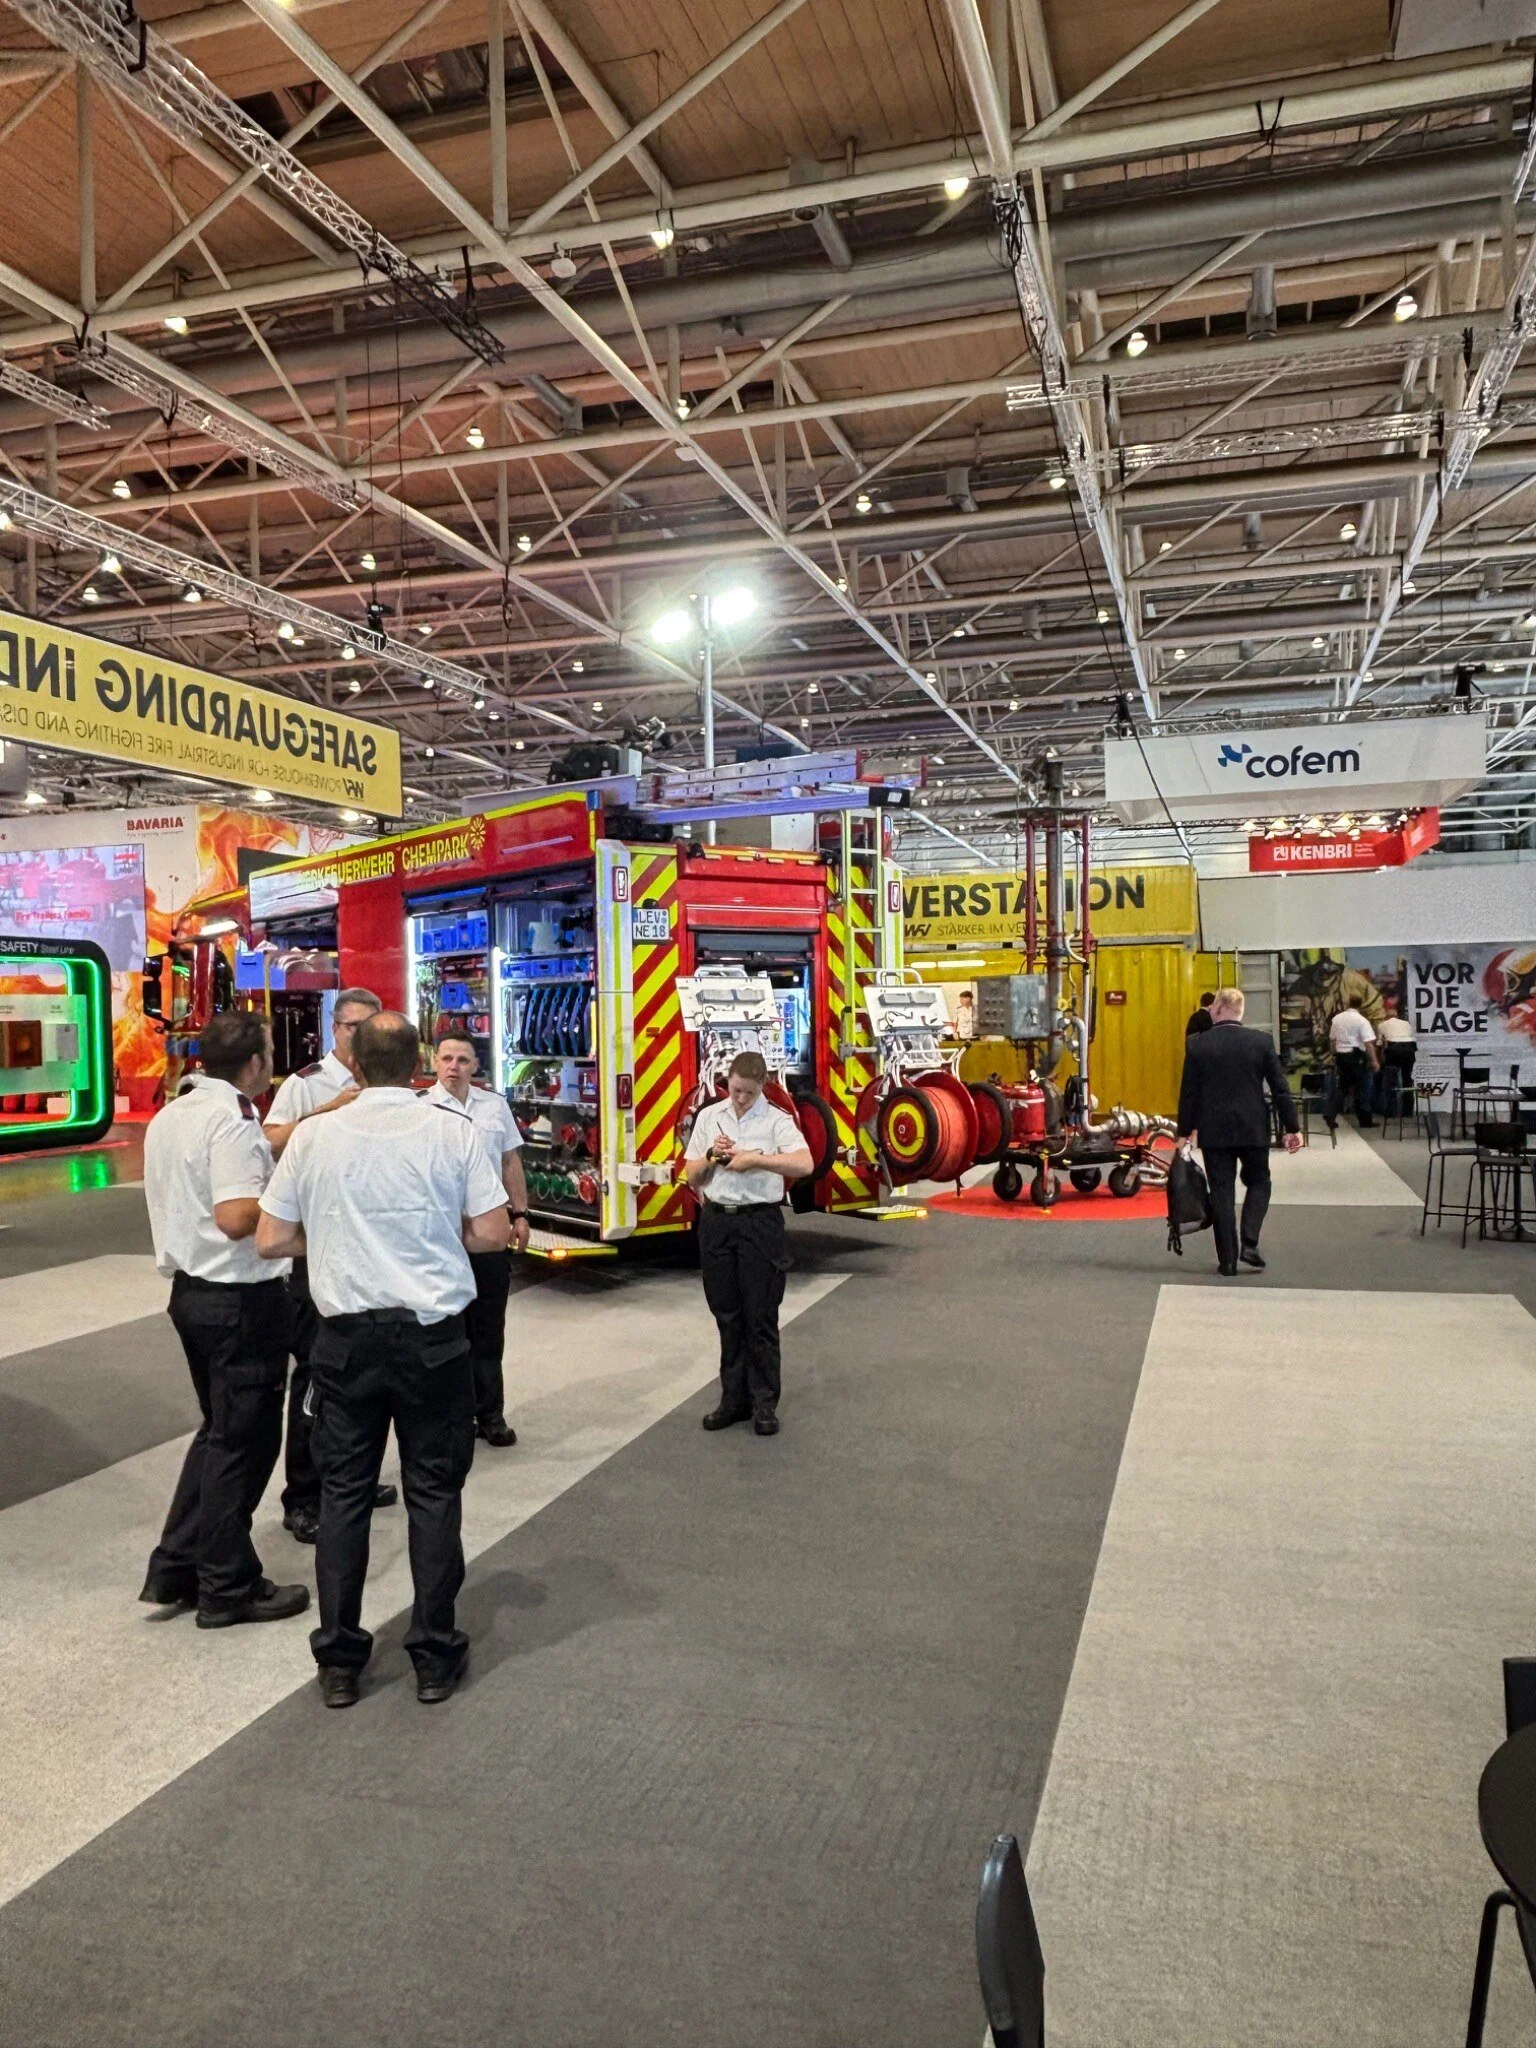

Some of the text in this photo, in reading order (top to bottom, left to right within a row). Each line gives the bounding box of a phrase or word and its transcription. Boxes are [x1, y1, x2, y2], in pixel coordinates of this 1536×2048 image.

[1246, 745, 1360, 778] cofem
[127, 817, 183, 831] BAVARIA
[401, 833, 470, 870] CHEMPARK
[1291, 843, 1352, 860] KENBRI
[639, 910, 660, 924] LEV
[635, 925, 666, 937] NE 18
[0, 940, 38, 954] SAFETY
[1415, 962, 1475, 984] VOR
[1415, 987, 1460, 1009] DIE
[1415, 1010, 1488, 1033] LAGE
